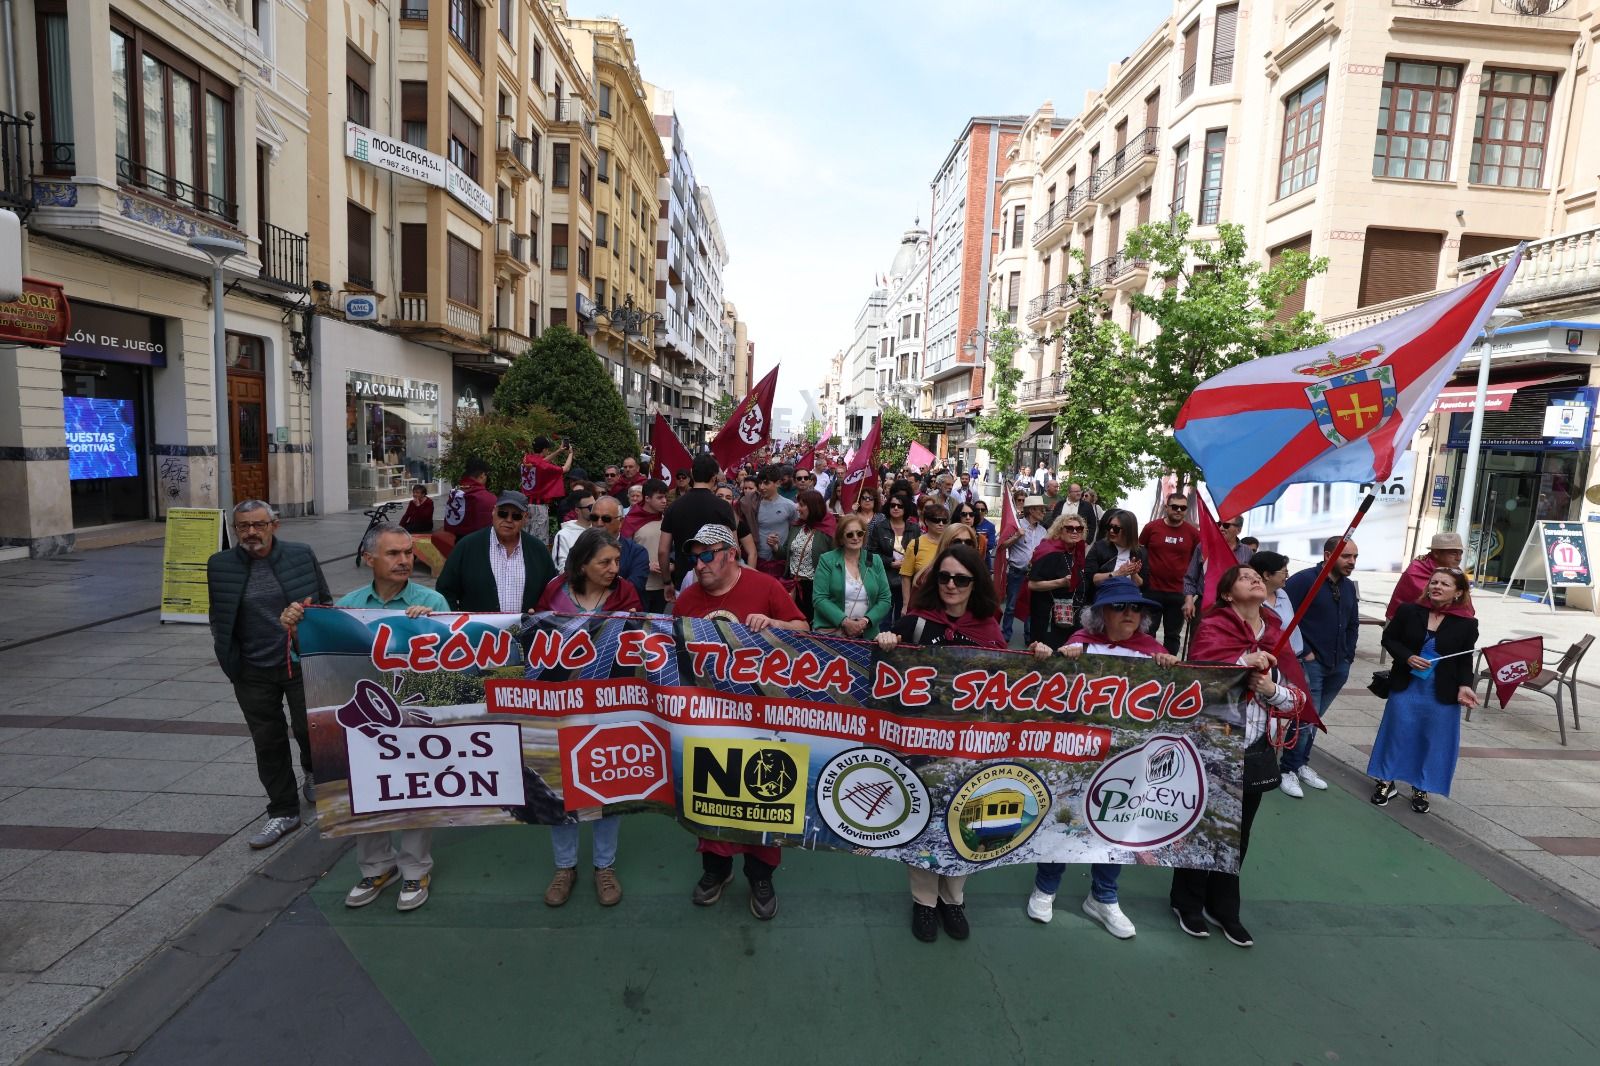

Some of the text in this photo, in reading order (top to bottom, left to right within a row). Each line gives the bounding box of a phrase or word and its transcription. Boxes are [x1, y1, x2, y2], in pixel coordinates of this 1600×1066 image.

[386, 158, 429, 179] 987 25 11 21
[37, 312, 56, 321] BAR
[351, 303, 369, 312] AMC
[101, 335, 119, 347] DE
[122, 338, 164, 353] JUEGO
[1559, 547, 1574, 563] 17
[372, 613, 1204, 722] LEÓN NO ES TIERRA DE SACRIFICIO
[494, 685, 1102, 757] MEGAPLANTAS SOLARES STOP CANTERAS MACROGRANJAS VERTEDEROS TÓXICOS STOP BIOGÁS
[377, 731, 494, 760] S.O.S
[590, 743, 656, 768] STOP
[376, 765, 499, 802] LEÓN
[590, 765, 655, 783] LODOS
[822, 754, 921, 815] TREN RUTA DE LA PLATA
[953, 769, 1048, 812] PLATAFORMA DEFENSA
[695, 800, 792, 822] PARQUES EÓLICOS
[837, 821, 901, 842] Movimiento
[990, 844, 1012, 858] LEÓN
